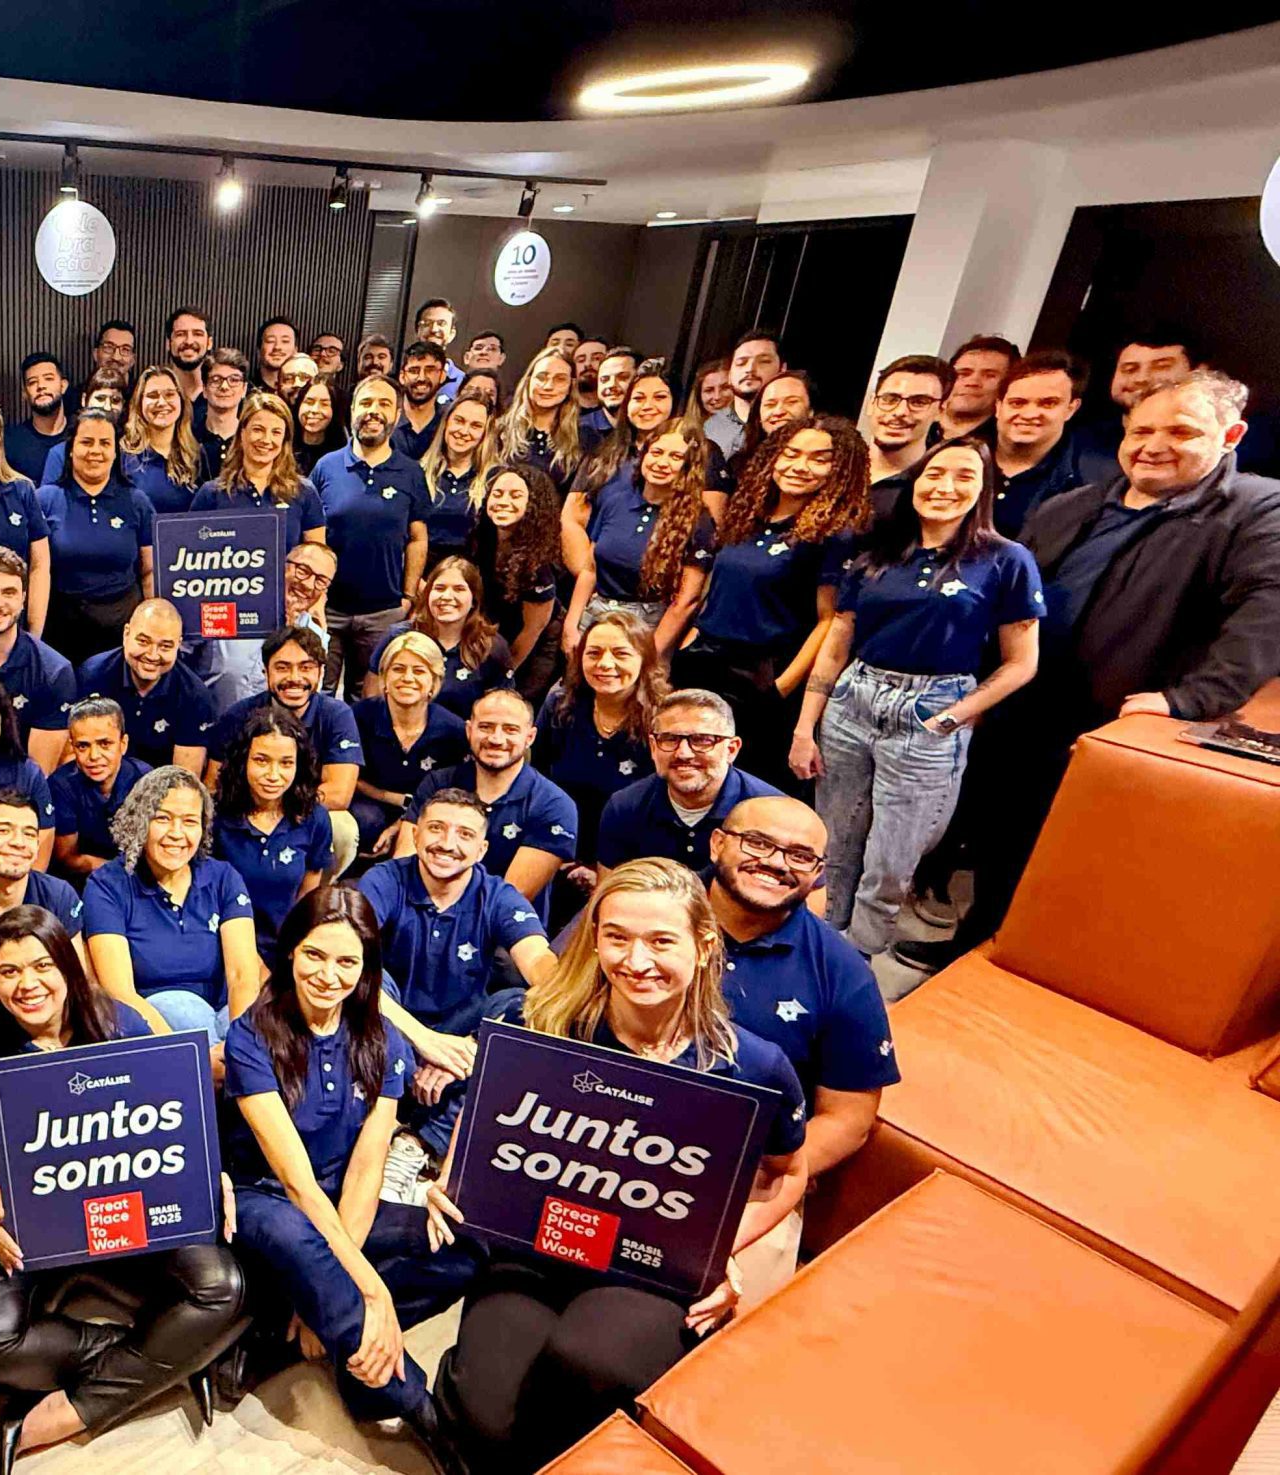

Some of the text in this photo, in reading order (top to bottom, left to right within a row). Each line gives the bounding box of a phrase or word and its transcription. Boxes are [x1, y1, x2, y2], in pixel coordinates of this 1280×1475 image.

[511, 244, 537, 266] 10
[169, 546, 266, 571] Juntos
[171, 576, 265, 597] somos
[203, 604, 228, 613] Great
[86, 1075, 131, 1089] CATÁLISE
[595, 1084, 654, 1107] CATÁLISE
[23, 1100, 183, 1153] Juntos
[495, 1091, 712, 1176] Juntos
[32, 1144, 185, 1195] somos
[490, 1143, 695, 1220] somos
[88, 1198, 128, 1214] Great
[148, 1204, 181, 1216] BRASIL
[548, 1201, 600, 1226] Great
[90, 1212, 129, 1226] Place
[151, 1212, 182, 1226] 2025
[547, 1213, 596, 1238] Place
[91, 1227, 107, 1238] To
[544, 1225, 562, 1240] To
[621, 1247, 661, 1268] 2025
[622, 1238, 663, 1258] BRASIL
